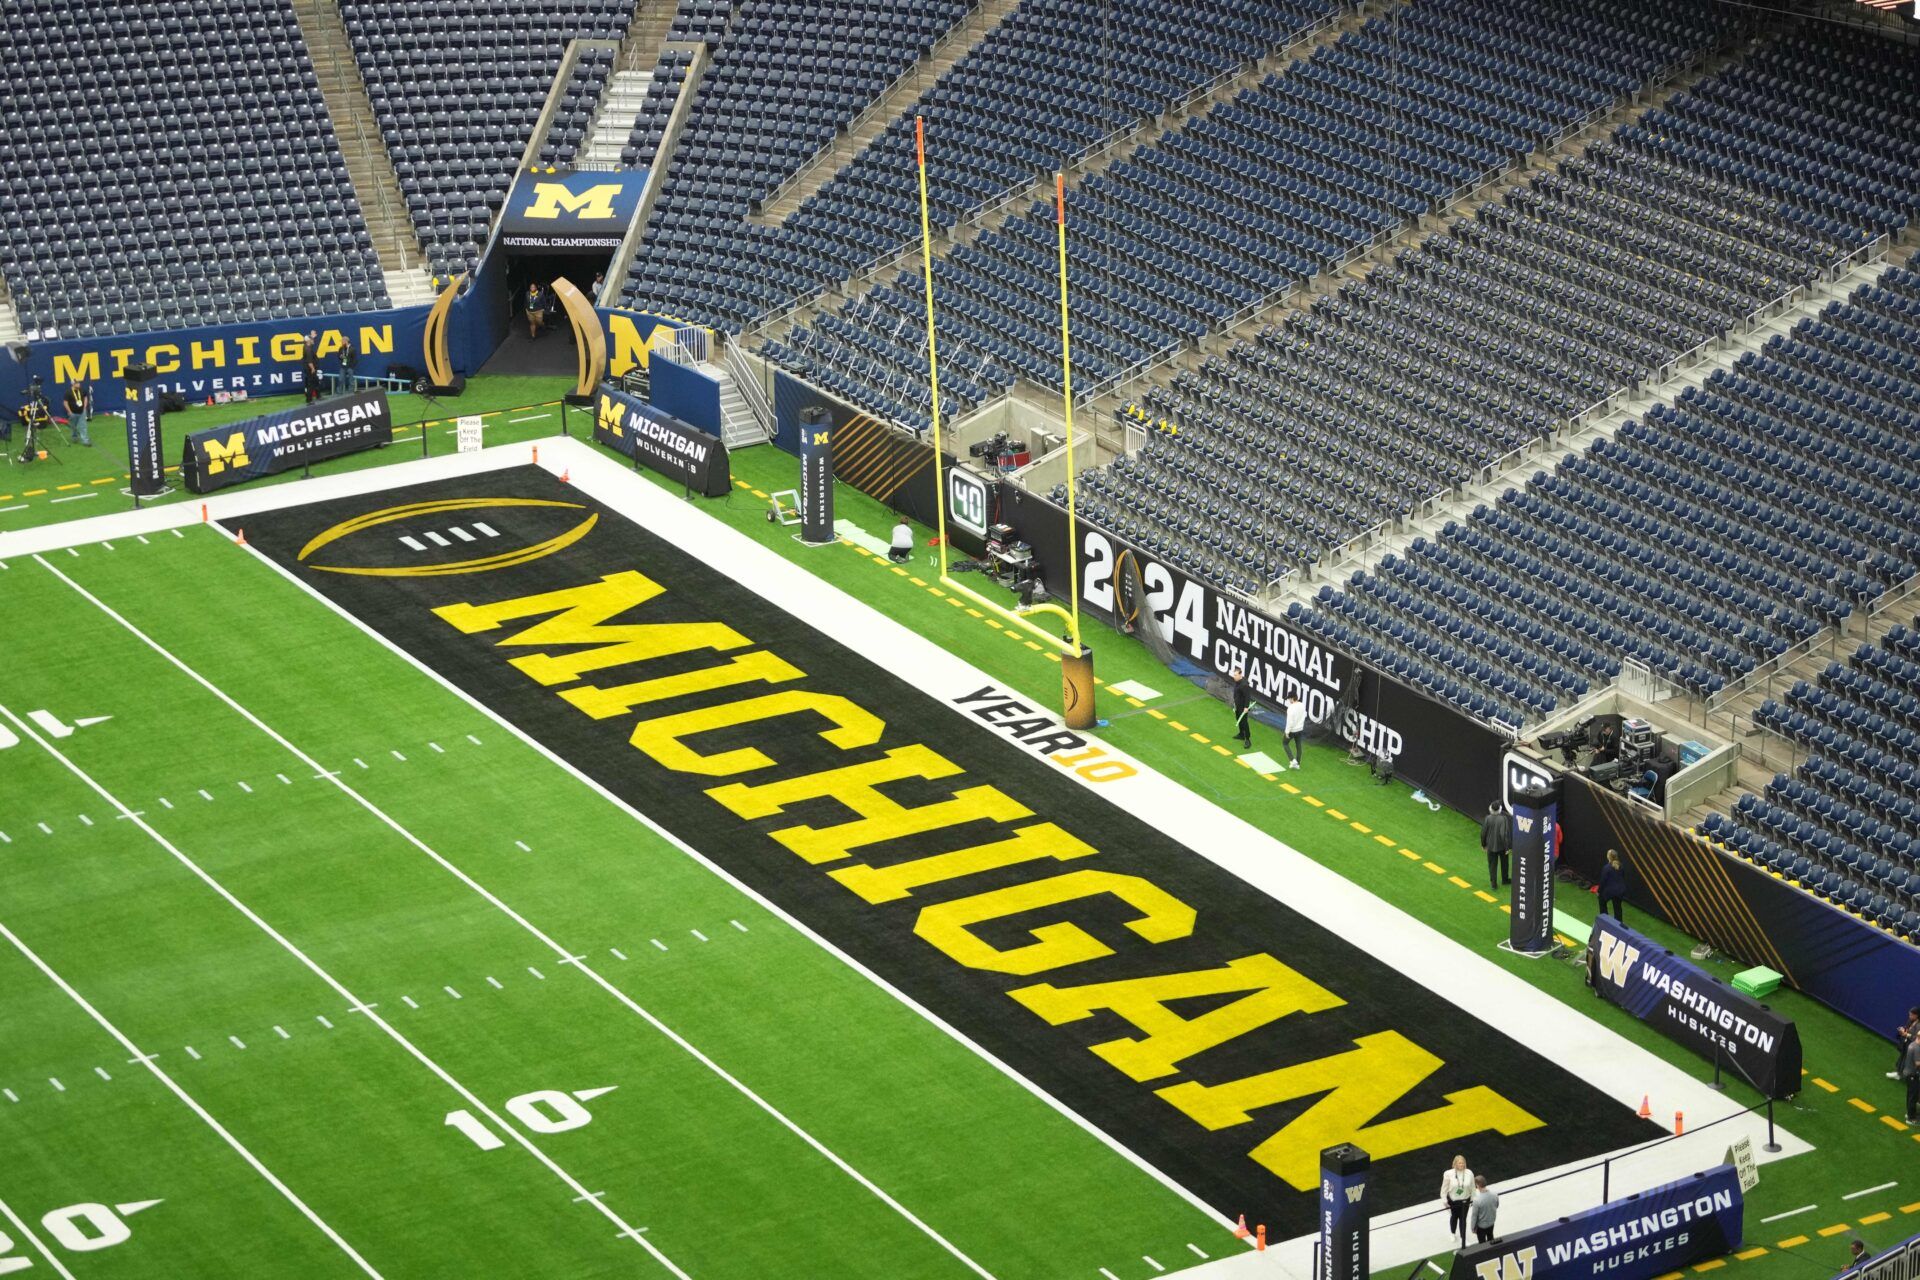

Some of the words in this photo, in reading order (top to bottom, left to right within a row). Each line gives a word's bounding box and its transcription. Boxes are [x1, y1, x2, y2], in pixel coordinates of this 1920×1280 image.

[524, 182, 624, 219] M
[503, 237, 550, 246] NATIONAL
[551, 238, 622, 247] CHAMPIONSHIP
[53, 324, 394, 384] MICHIGAN
[125, 386, 138, 402] M
[598, 394, 626, 438] M
[147, 410, 160, 480] MICHIGAN
[257, 400, 382, 445] MICHIGAN
[273, 424, 372, 457] WOLVERINES
[629, 413, 707, 463] MICHIGAN
[814, 432, 828, 446] M
[203, 432, 252, 476] M
[636, 437, 697, 474] WOLVERINS
[955, 480, 982, 525] 40
[1216, 596, 1341, 692] NATIONAL
[1516, 814, 1534, 832] W
[430, 570, 1548, 1192] MICHIGAN
[1541, 840, 1550, 938] WASHINGTON
[1598, 930, 1640, 988] W
[1642, 962, 1775, 1054] WASHINGTON
[1668, 1004, 1737, 1054] HUSKIES
[444, 1090, 592, 1150] 10
[1345, 1183, 1365, 1204] W
[1547, 1189, 1732, 1266] WASHINGTON
[1476, 1246, 1538, 1280] W
[1592, 1232, 1690, 1274] HUSKIES
